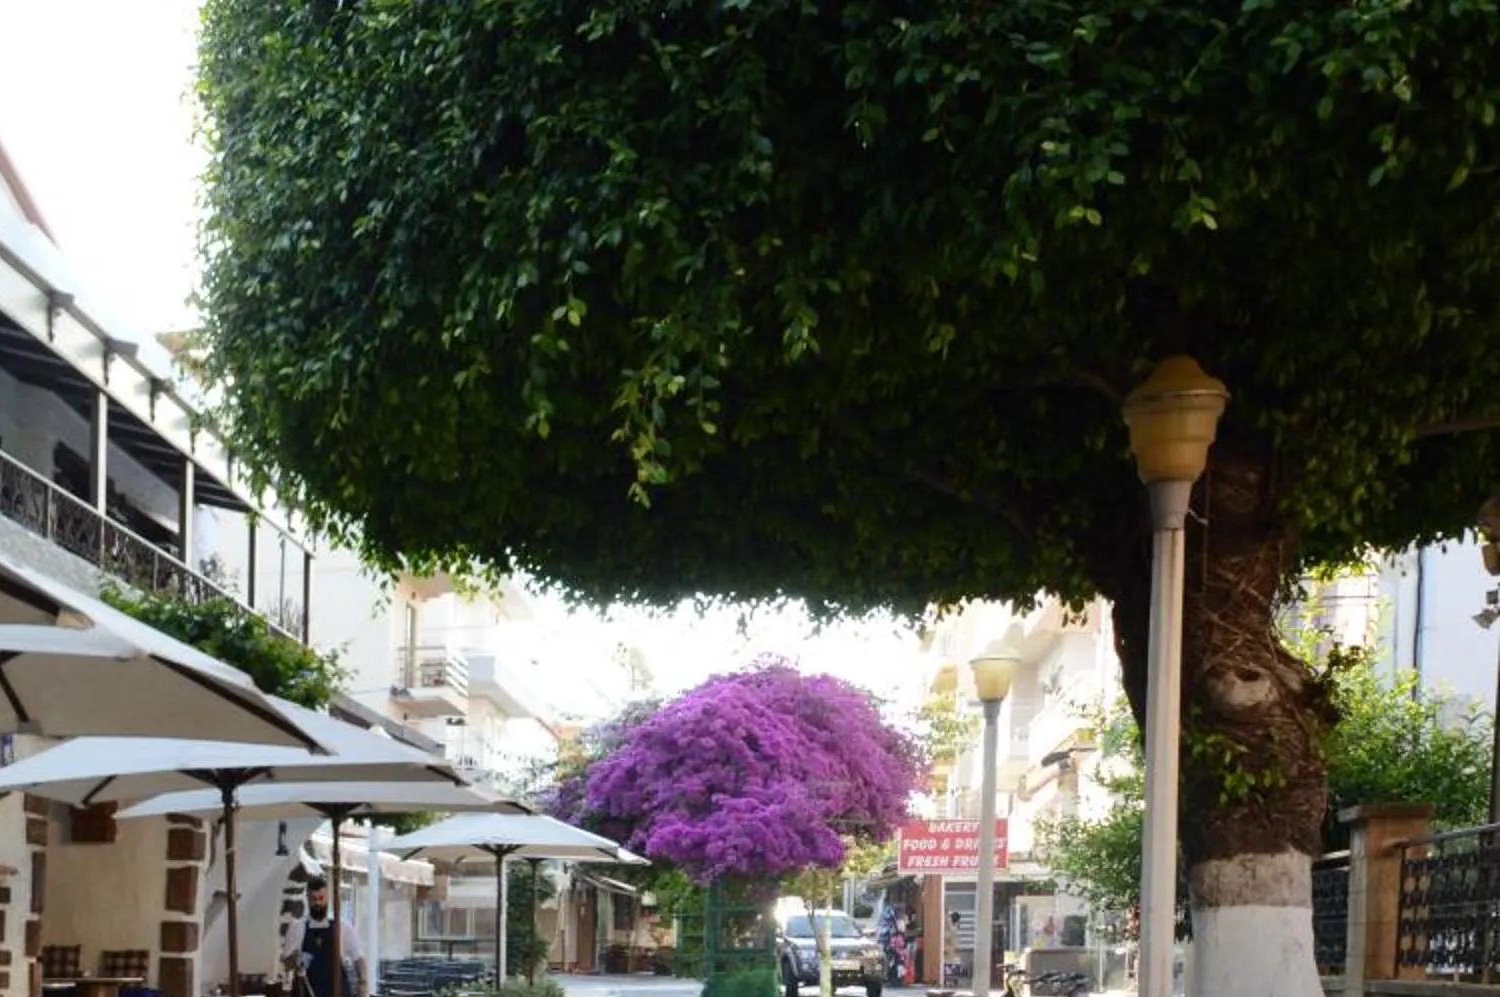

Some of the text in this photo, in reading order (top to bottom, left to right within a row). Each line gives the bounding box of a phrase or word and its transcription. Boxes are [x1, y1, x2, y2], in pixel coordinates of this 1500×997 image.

[903, 838, 937, 850] FOOD
[941, 838, 950, 850] &
[907, 855, 949, 868] FRESH
